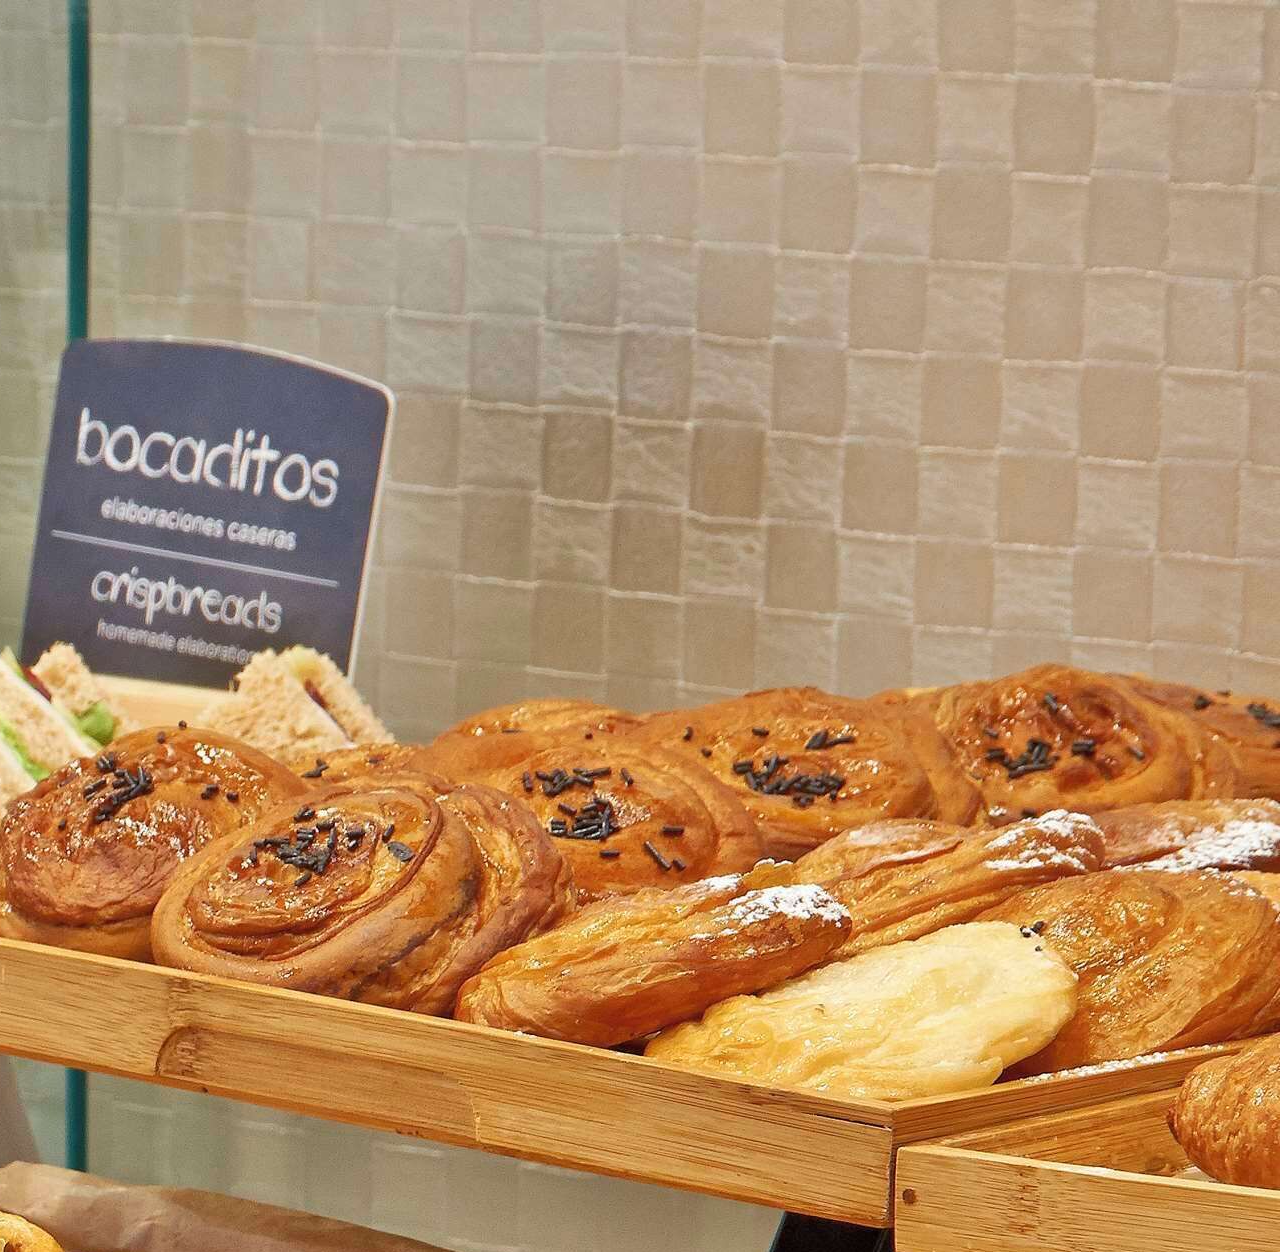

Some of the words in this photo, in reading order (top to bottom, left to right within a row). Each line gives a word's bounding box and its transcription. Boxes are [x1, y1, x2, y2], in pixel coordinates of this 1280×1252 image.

[76, 407, 340, 508] bocaditos
[101, 495, 225, 539] elaboraciones
[227, 519, 298, 551] caseras
[91, 566, 283, 633] crispbreads
[97, 617, 177, 651] homemade
